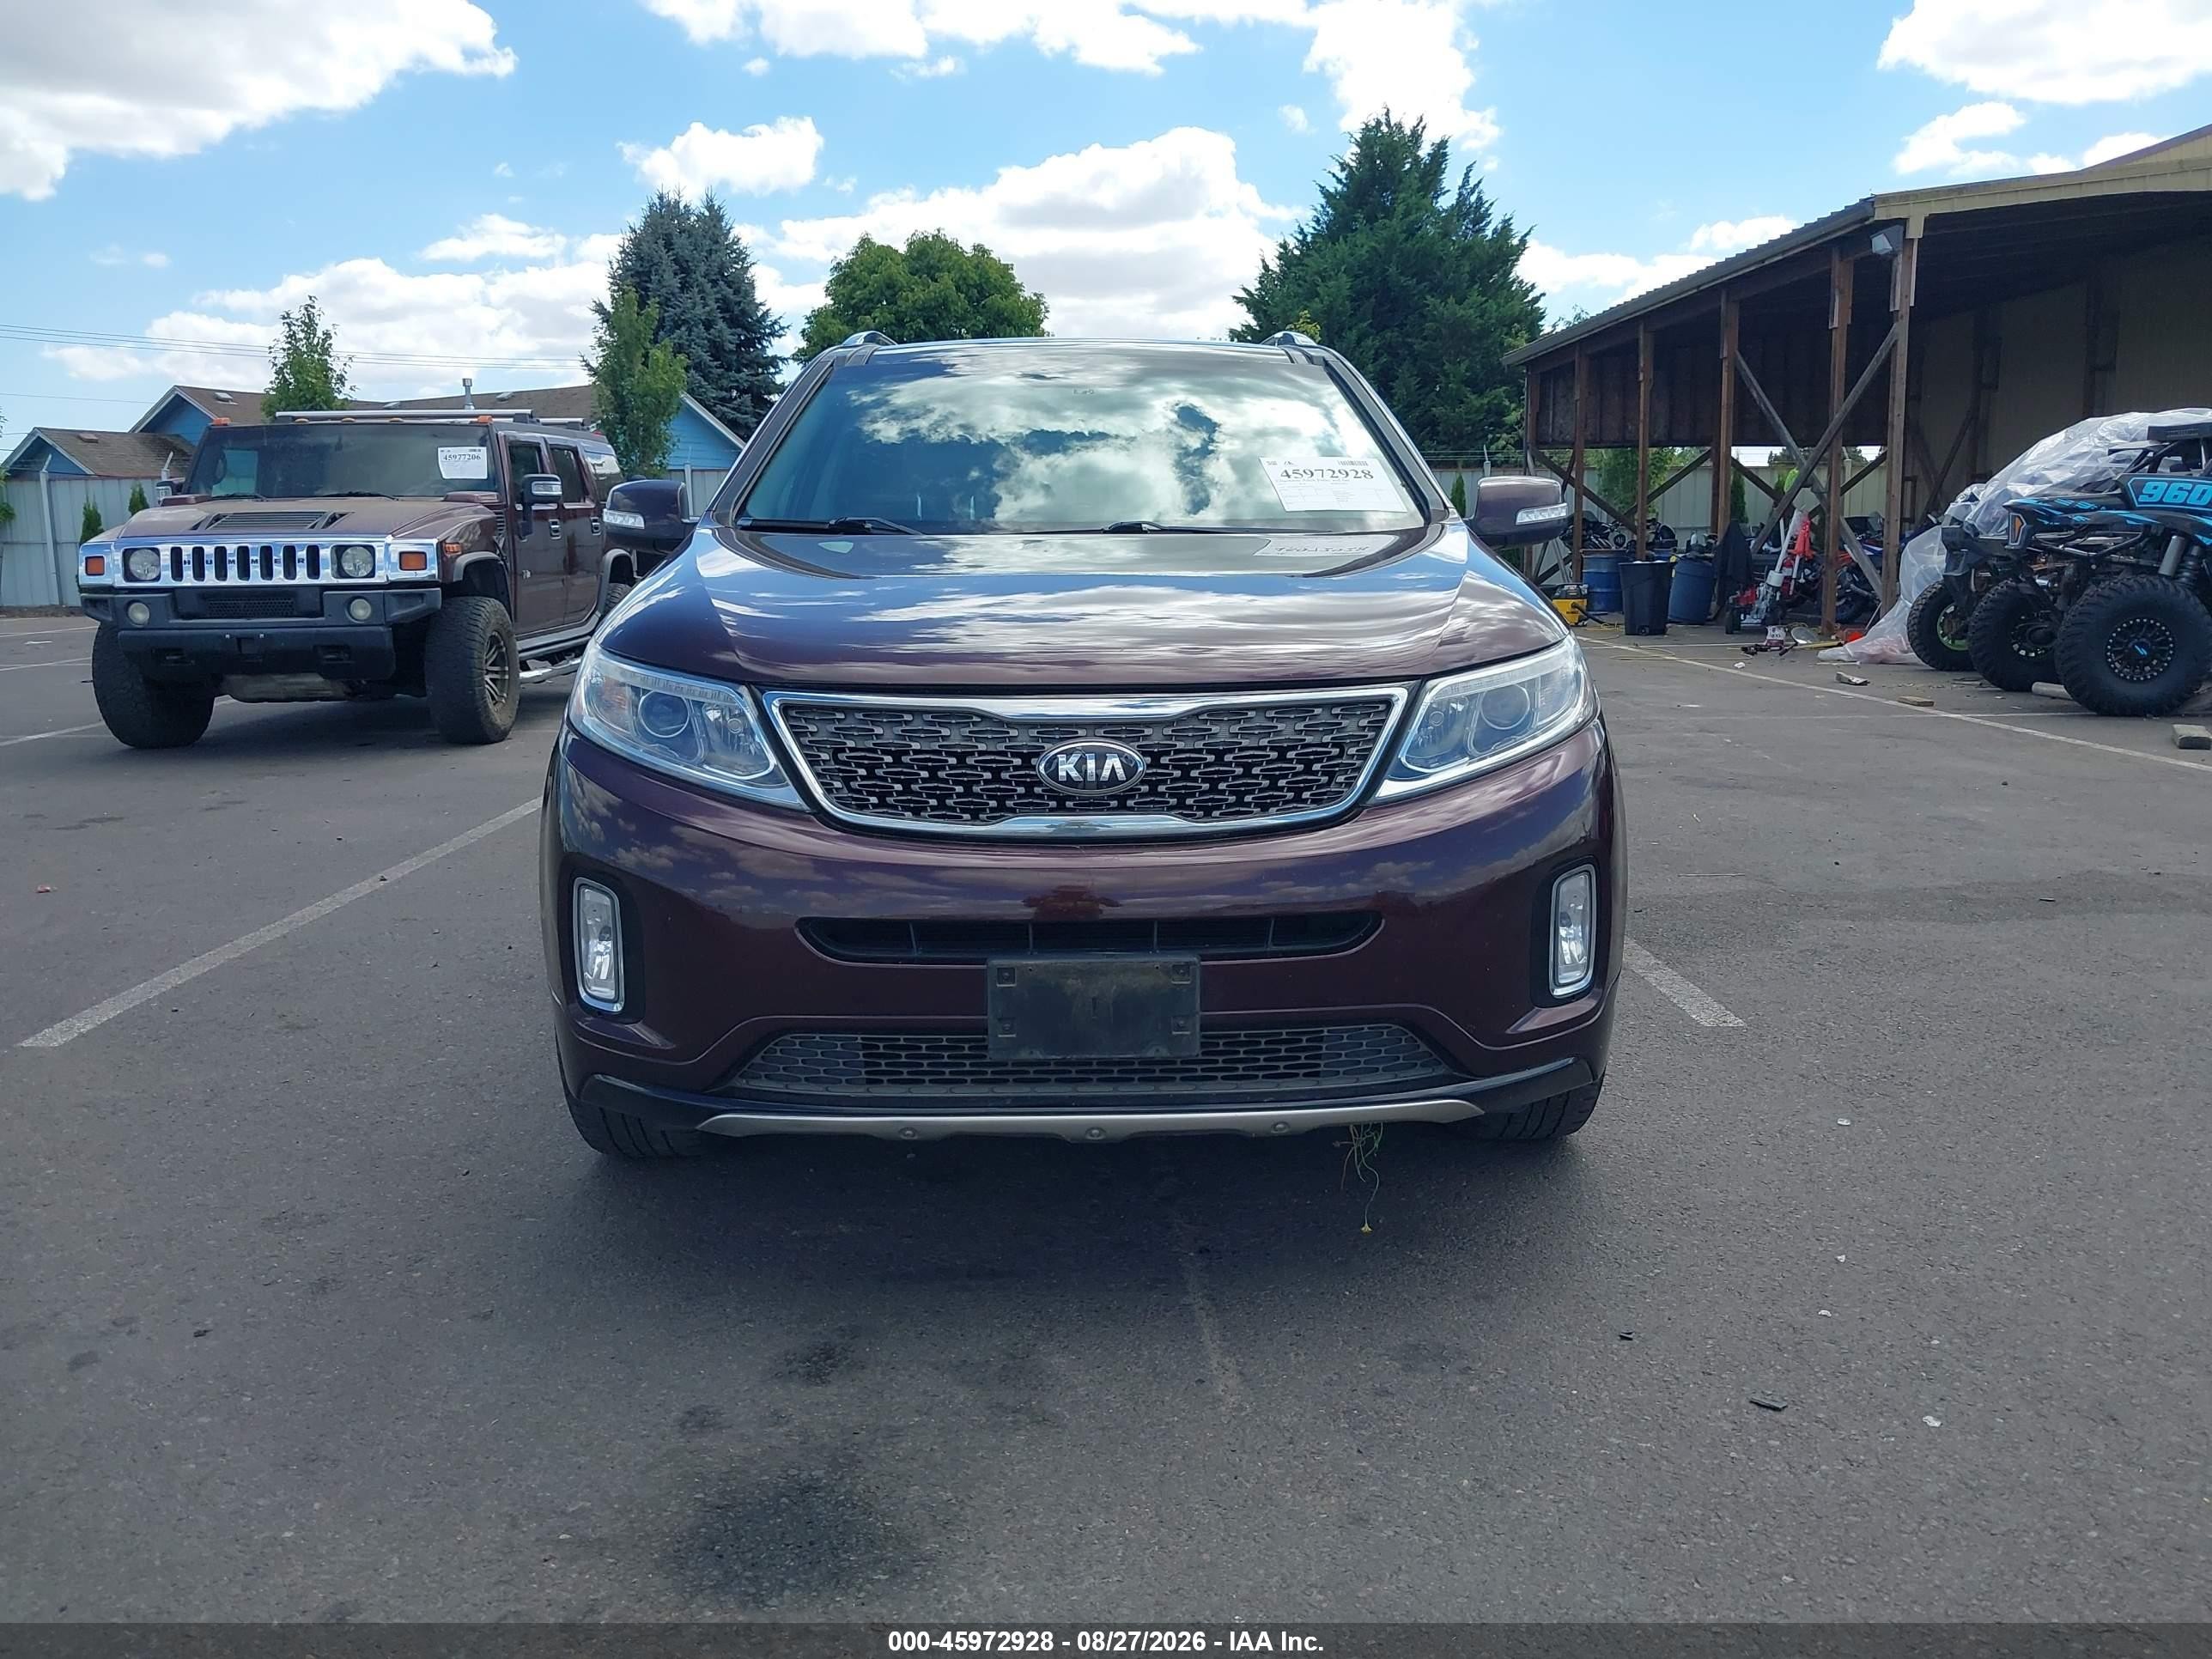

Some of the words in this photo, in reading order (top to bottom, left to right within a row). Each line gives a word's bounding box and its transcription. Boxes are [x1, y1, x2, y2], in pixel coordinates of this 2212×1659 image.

[1280, 468, 1374, 479] 45972928
[2138, 481, 2212, 505] 960
[183, 557, 306, 566] HUMMER
[1056, 752, 1127, 781] KIA
